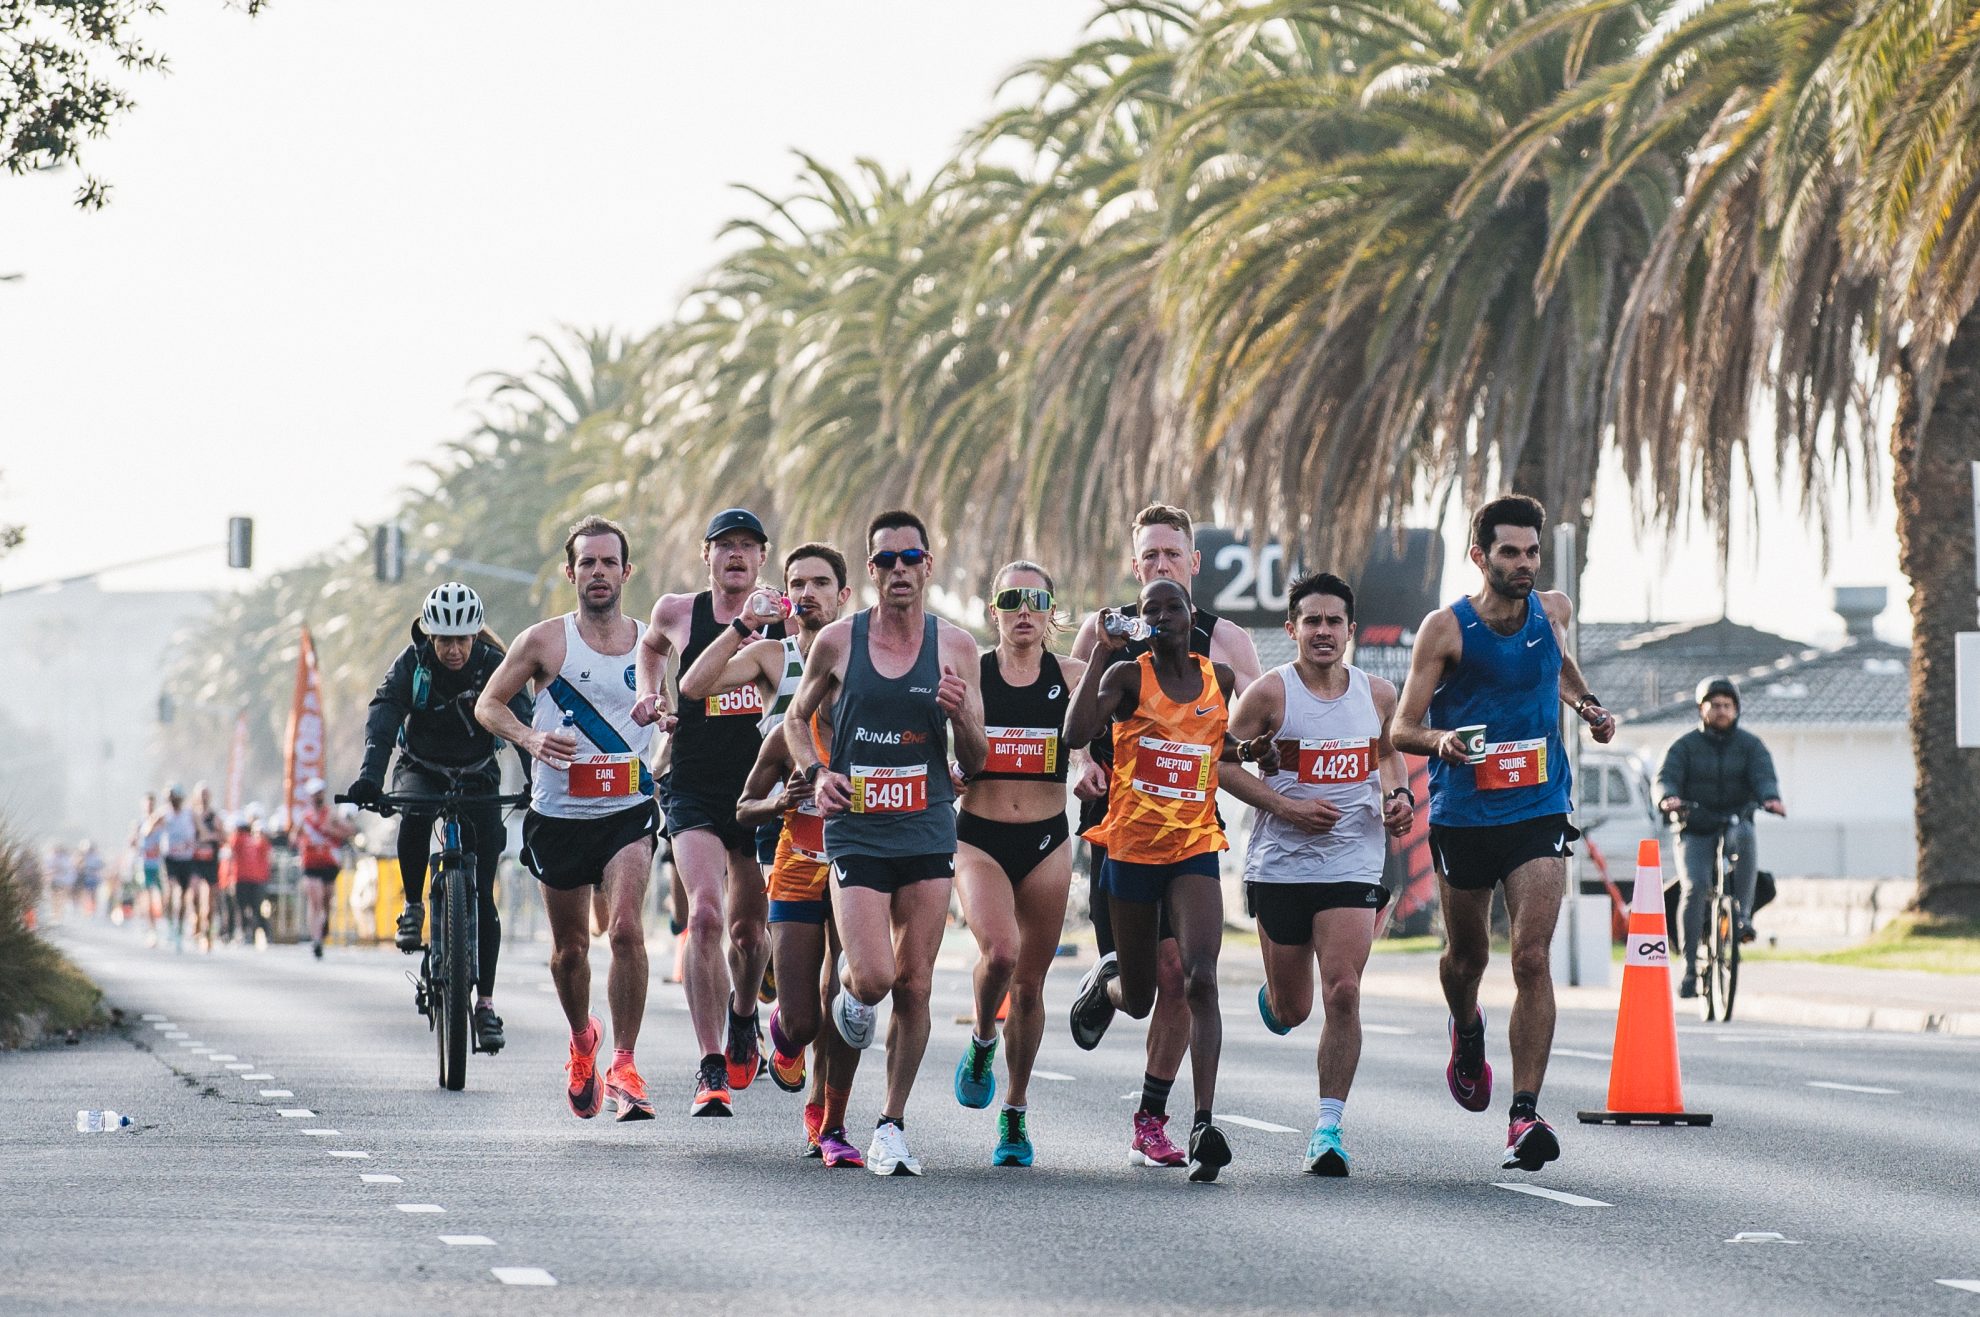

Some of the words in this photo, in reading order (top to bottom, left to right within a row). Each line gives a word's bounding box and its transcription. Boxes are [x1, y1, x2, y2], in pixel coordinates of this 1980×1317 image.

[1214, 544, 1300, 611] 20
[718, 685, 763, 711] 5568
[995, 743, 1044, 756] BATT-DOYLE
[1470, 734, 1484, 753] G
[1016, 757, 1022, 768] 4
[1047, 749, 1055, 771] ELITE
[1156, 756, 1192, 772] CHEPTOO
[1312, 753, 1359, 779] 4423
[1499, 756, 1527, 770] SQUIRE
[595, 769, 616, 780] EARL
[1168, 772, 1178, 784] 10
[1508, 771, 1520, 782] 26
[601, 782, 611, 792] 16
[865, 782, 913, 808] 5491
